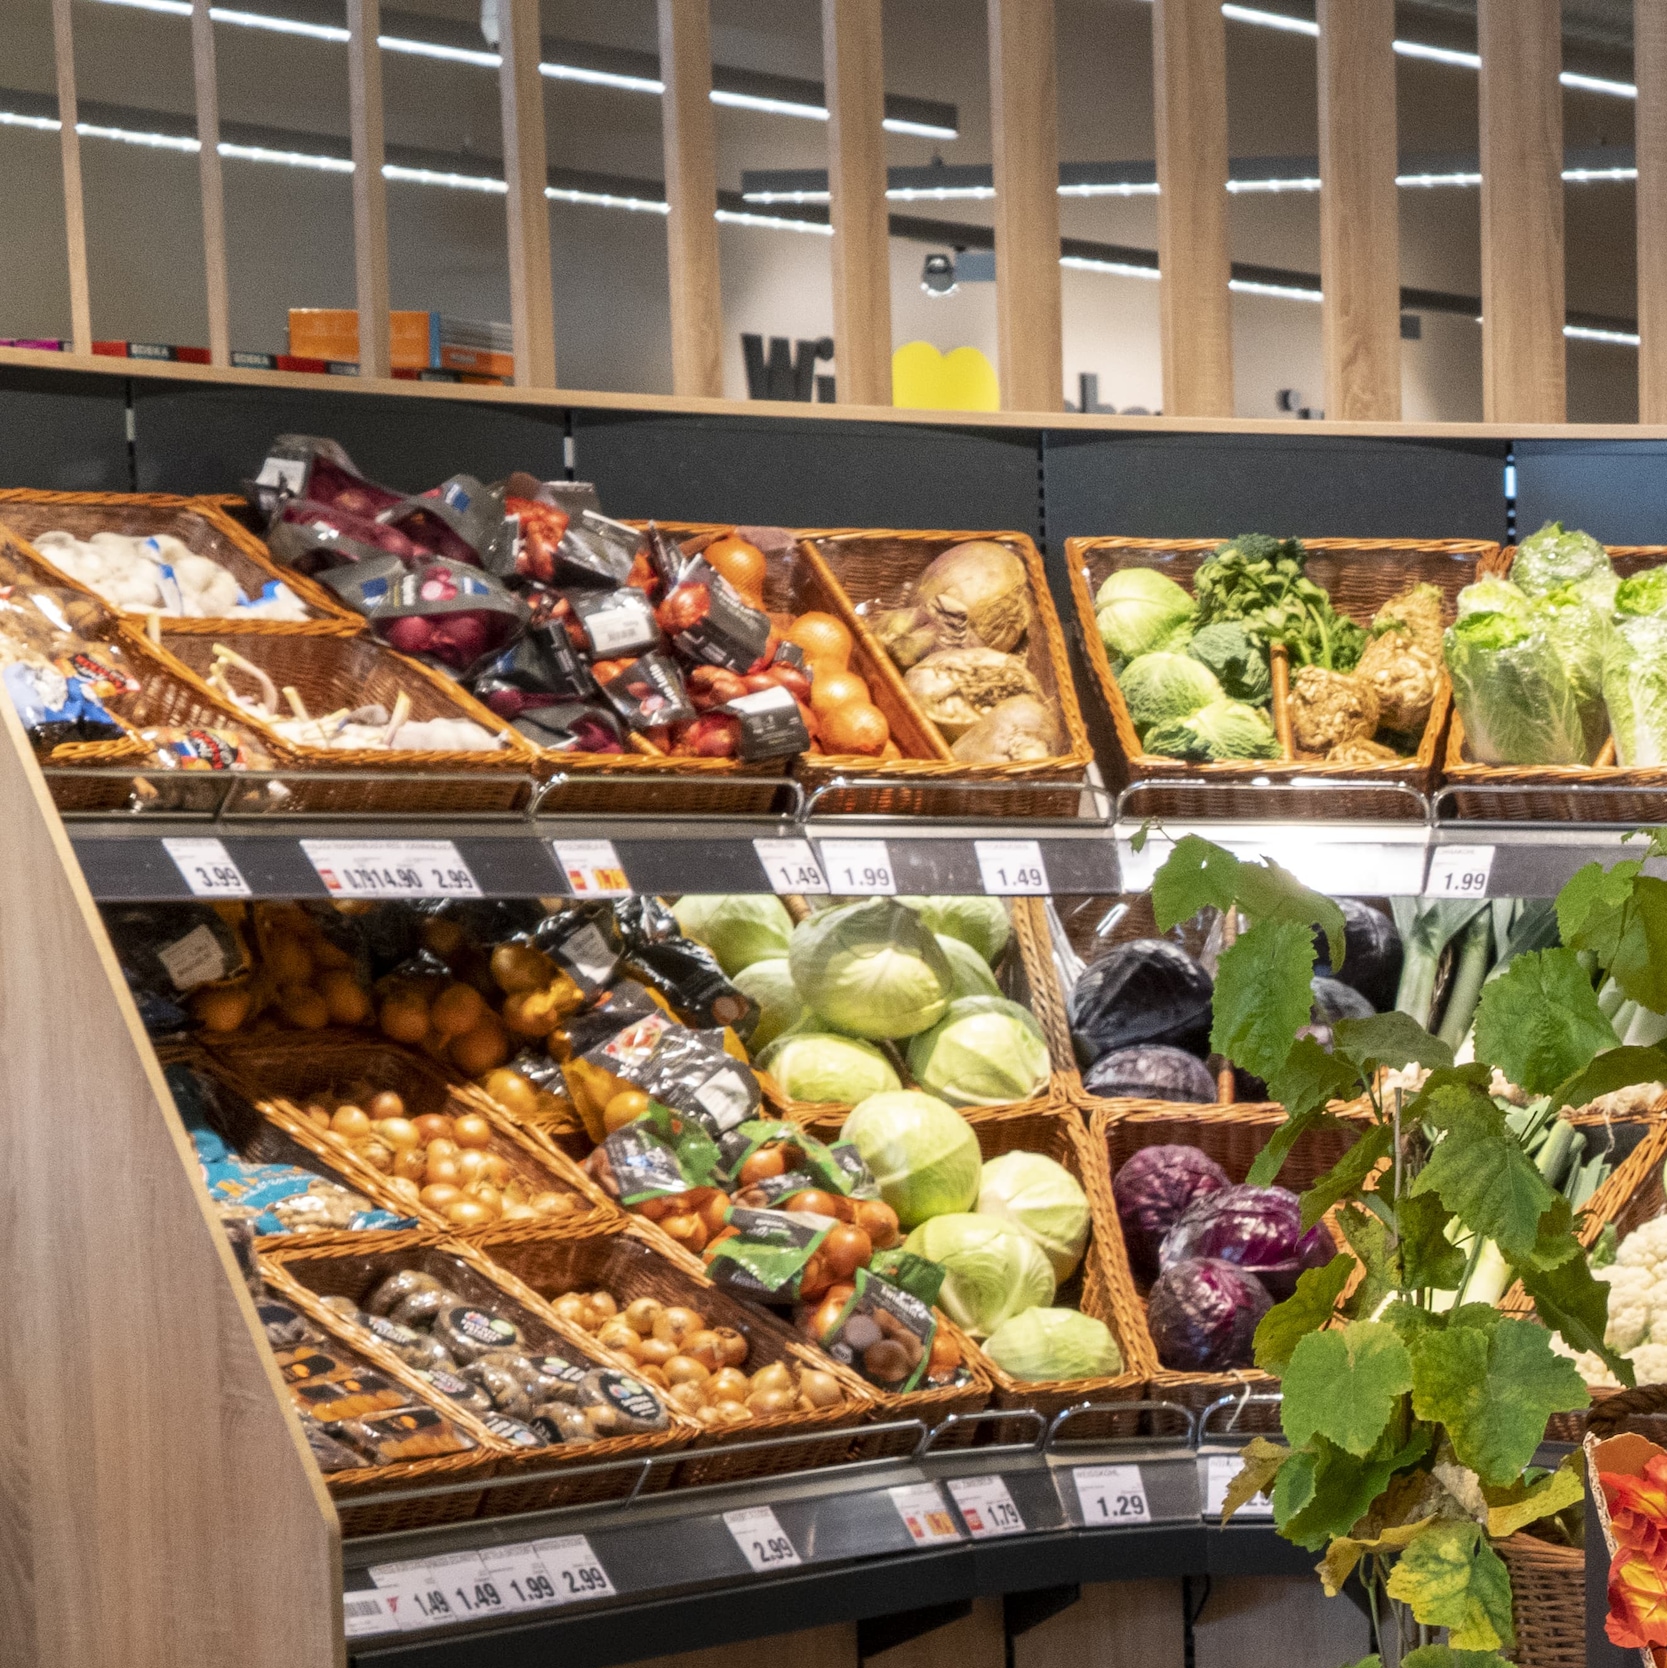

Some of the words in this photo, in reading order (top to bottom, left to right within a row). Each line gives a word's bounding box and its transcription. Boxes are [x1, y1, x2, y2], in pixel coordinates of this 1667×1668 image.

[195, 866, 241, 888] 3.99
[431, 868, 475, 890] 2.99
[779, 865, 822, 888] 1.49
[843, 867, 890, 887] 1.99
[996, 867, 1044, 888] 1.49
[1444, 872, 1486, 891] 1.99
[987, 1502, 1020, 1526] 1.79
[1096, 1494, 1146, 1519] 1.29
[752, 1536, 794, 1563] 2.99
[414, 1589, 451, 1617] 1.49
[454, 1581, 502, 1611] 1.49
[509, 1574, 556, 1602] 1.99
[561, 1566, 608, 1594] 2.99
